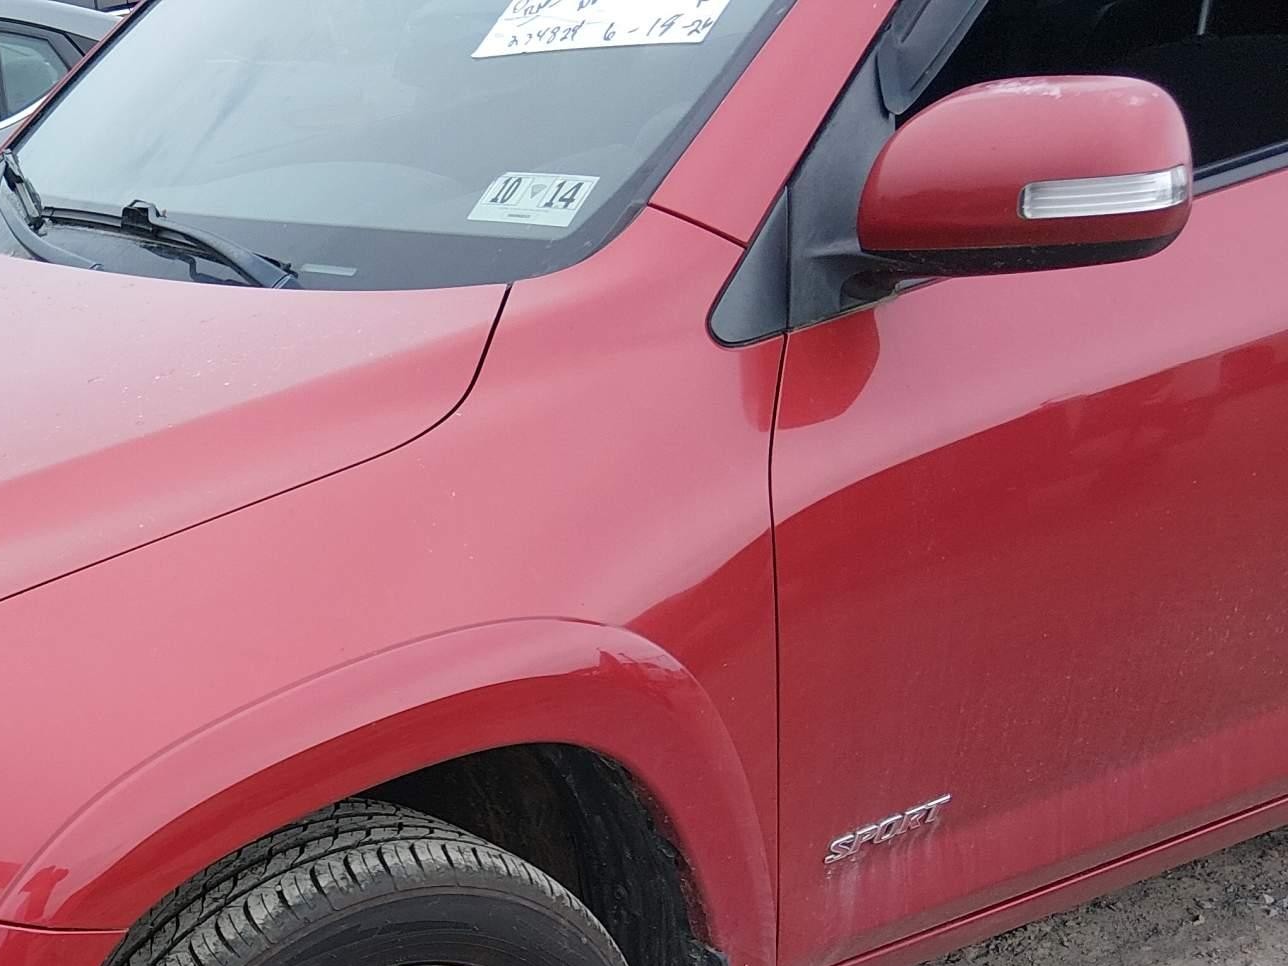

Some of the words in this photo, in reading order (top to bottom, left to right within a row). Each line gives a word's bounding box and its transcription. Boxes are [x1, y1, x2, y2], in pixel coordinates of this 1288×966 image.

[489, 175, 523, 204] 10
[542, 179, 585, 209] 14
[823, 793, 953, 865] SPORT
